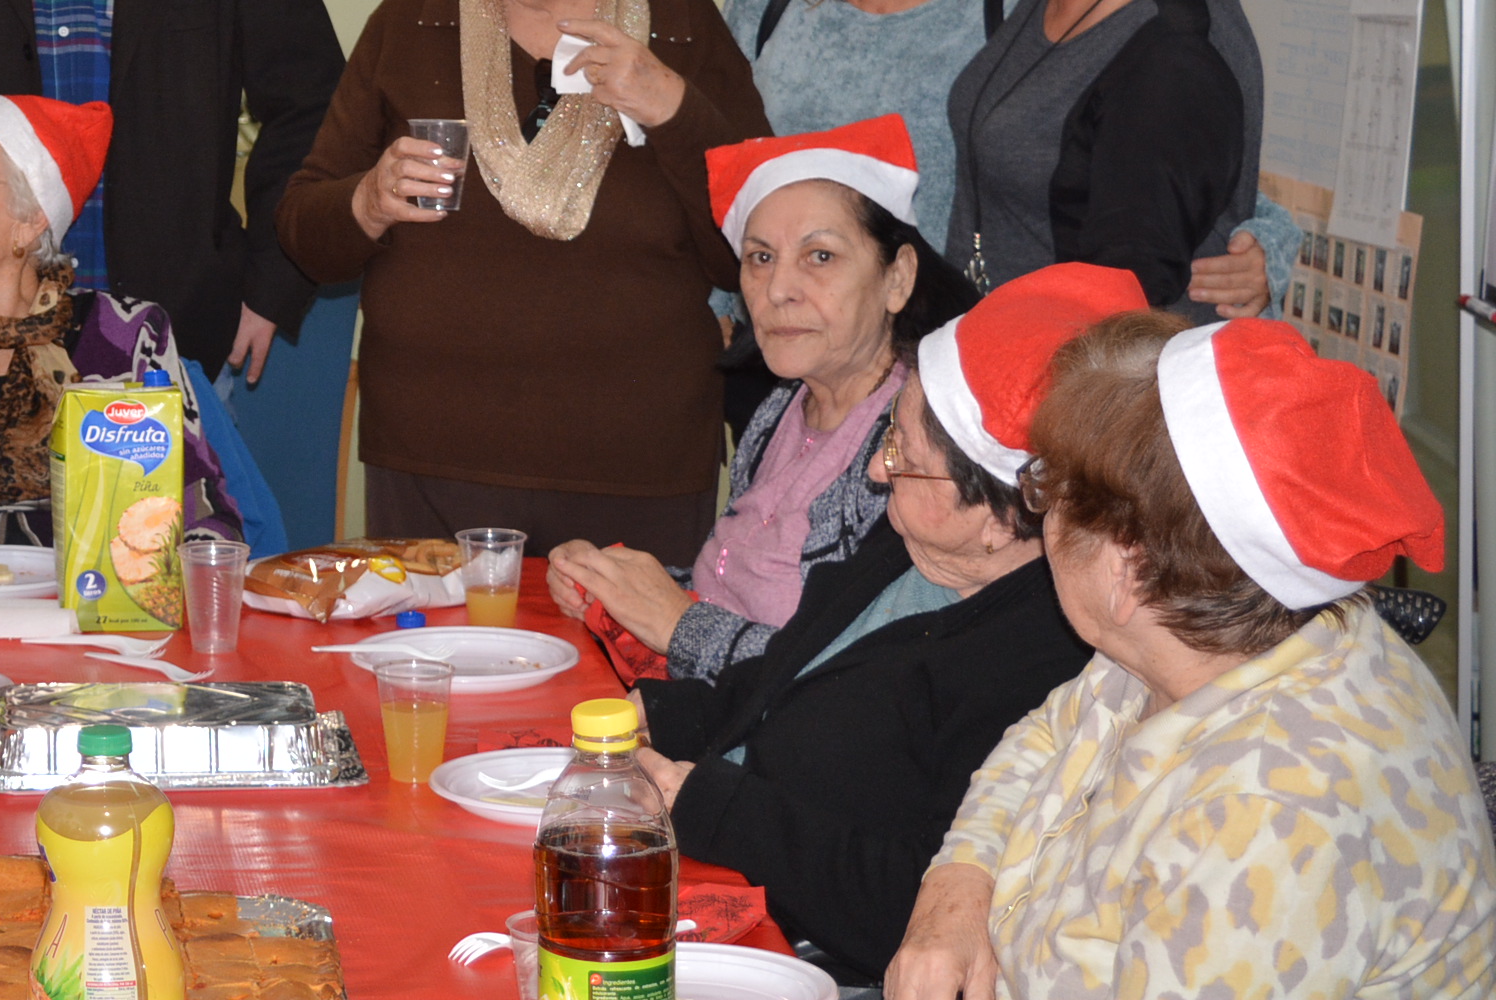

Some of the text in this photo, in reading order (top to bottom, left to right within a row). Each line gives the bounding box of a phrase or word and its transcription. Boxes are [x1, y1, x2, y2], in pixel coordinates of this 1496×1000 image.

[107, 406, 144, 418] Juver
[84, 424, 167, 444] Disfruta
[119, 444, 166, 456] sin azúcares
[130, 452, 165, 461] añadidos
[132, 480, 161, 492] Piña
[84, 573, 98, 589] 2
[83, 589, 102, 597] litros
[602, 979, 636, 987] Ingredientes
